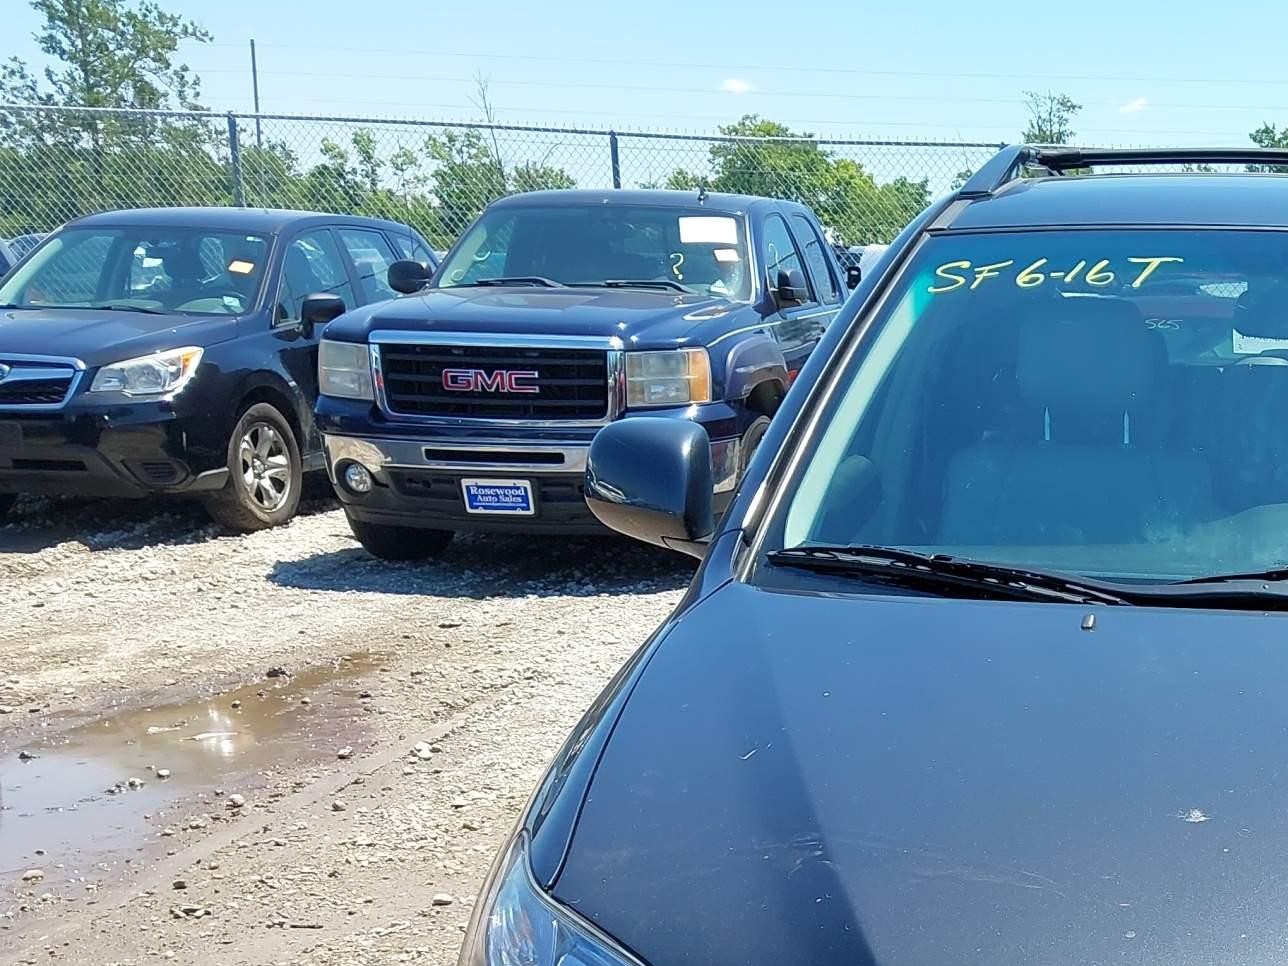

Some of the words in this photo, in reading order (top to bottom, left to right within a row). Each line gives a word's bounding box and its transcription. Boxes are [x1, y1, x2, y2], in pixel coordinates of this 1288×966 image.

[927, 259, 1014, 293] SF
[1015, 258, 1115, 288] 6-16
[1127, 257, 1184, 288] T
[442, 368, 541, 393] GMC
[469, 486, 525, 496] Rosewood
[476, 494, 498, 502] Auto
[498, 495, 522, 503] Sales
